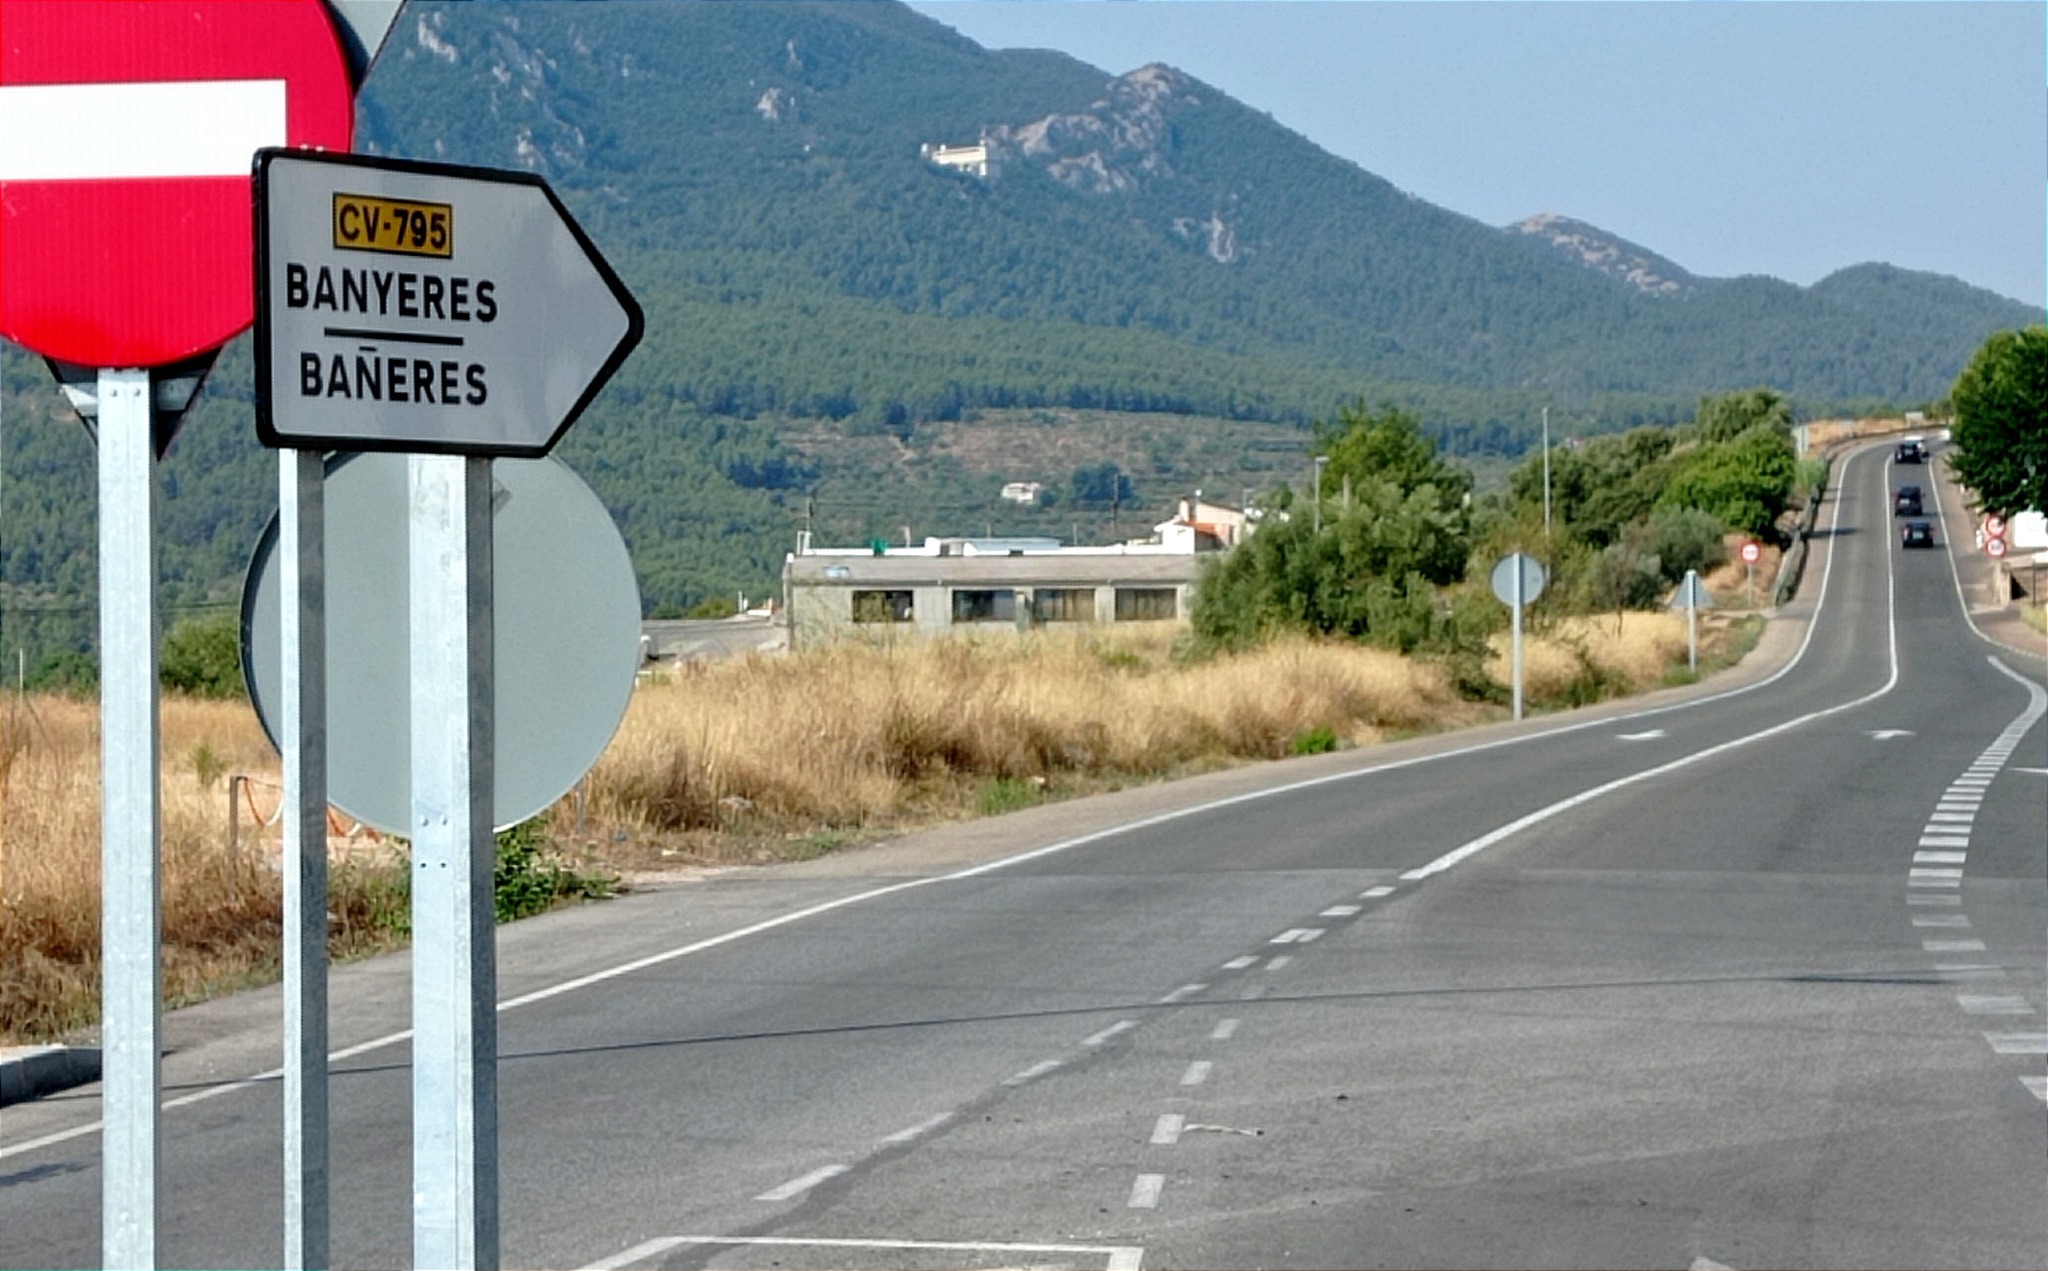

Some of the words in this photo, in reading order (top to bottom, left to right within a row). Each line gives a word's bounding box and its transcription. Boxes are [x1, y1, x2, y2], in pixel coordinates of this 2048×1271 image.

[339, 204, 447, 249] CV-795
[286, 262, 497, 323] BANYERES
[300, 346, 487, 406] BAÑERES
